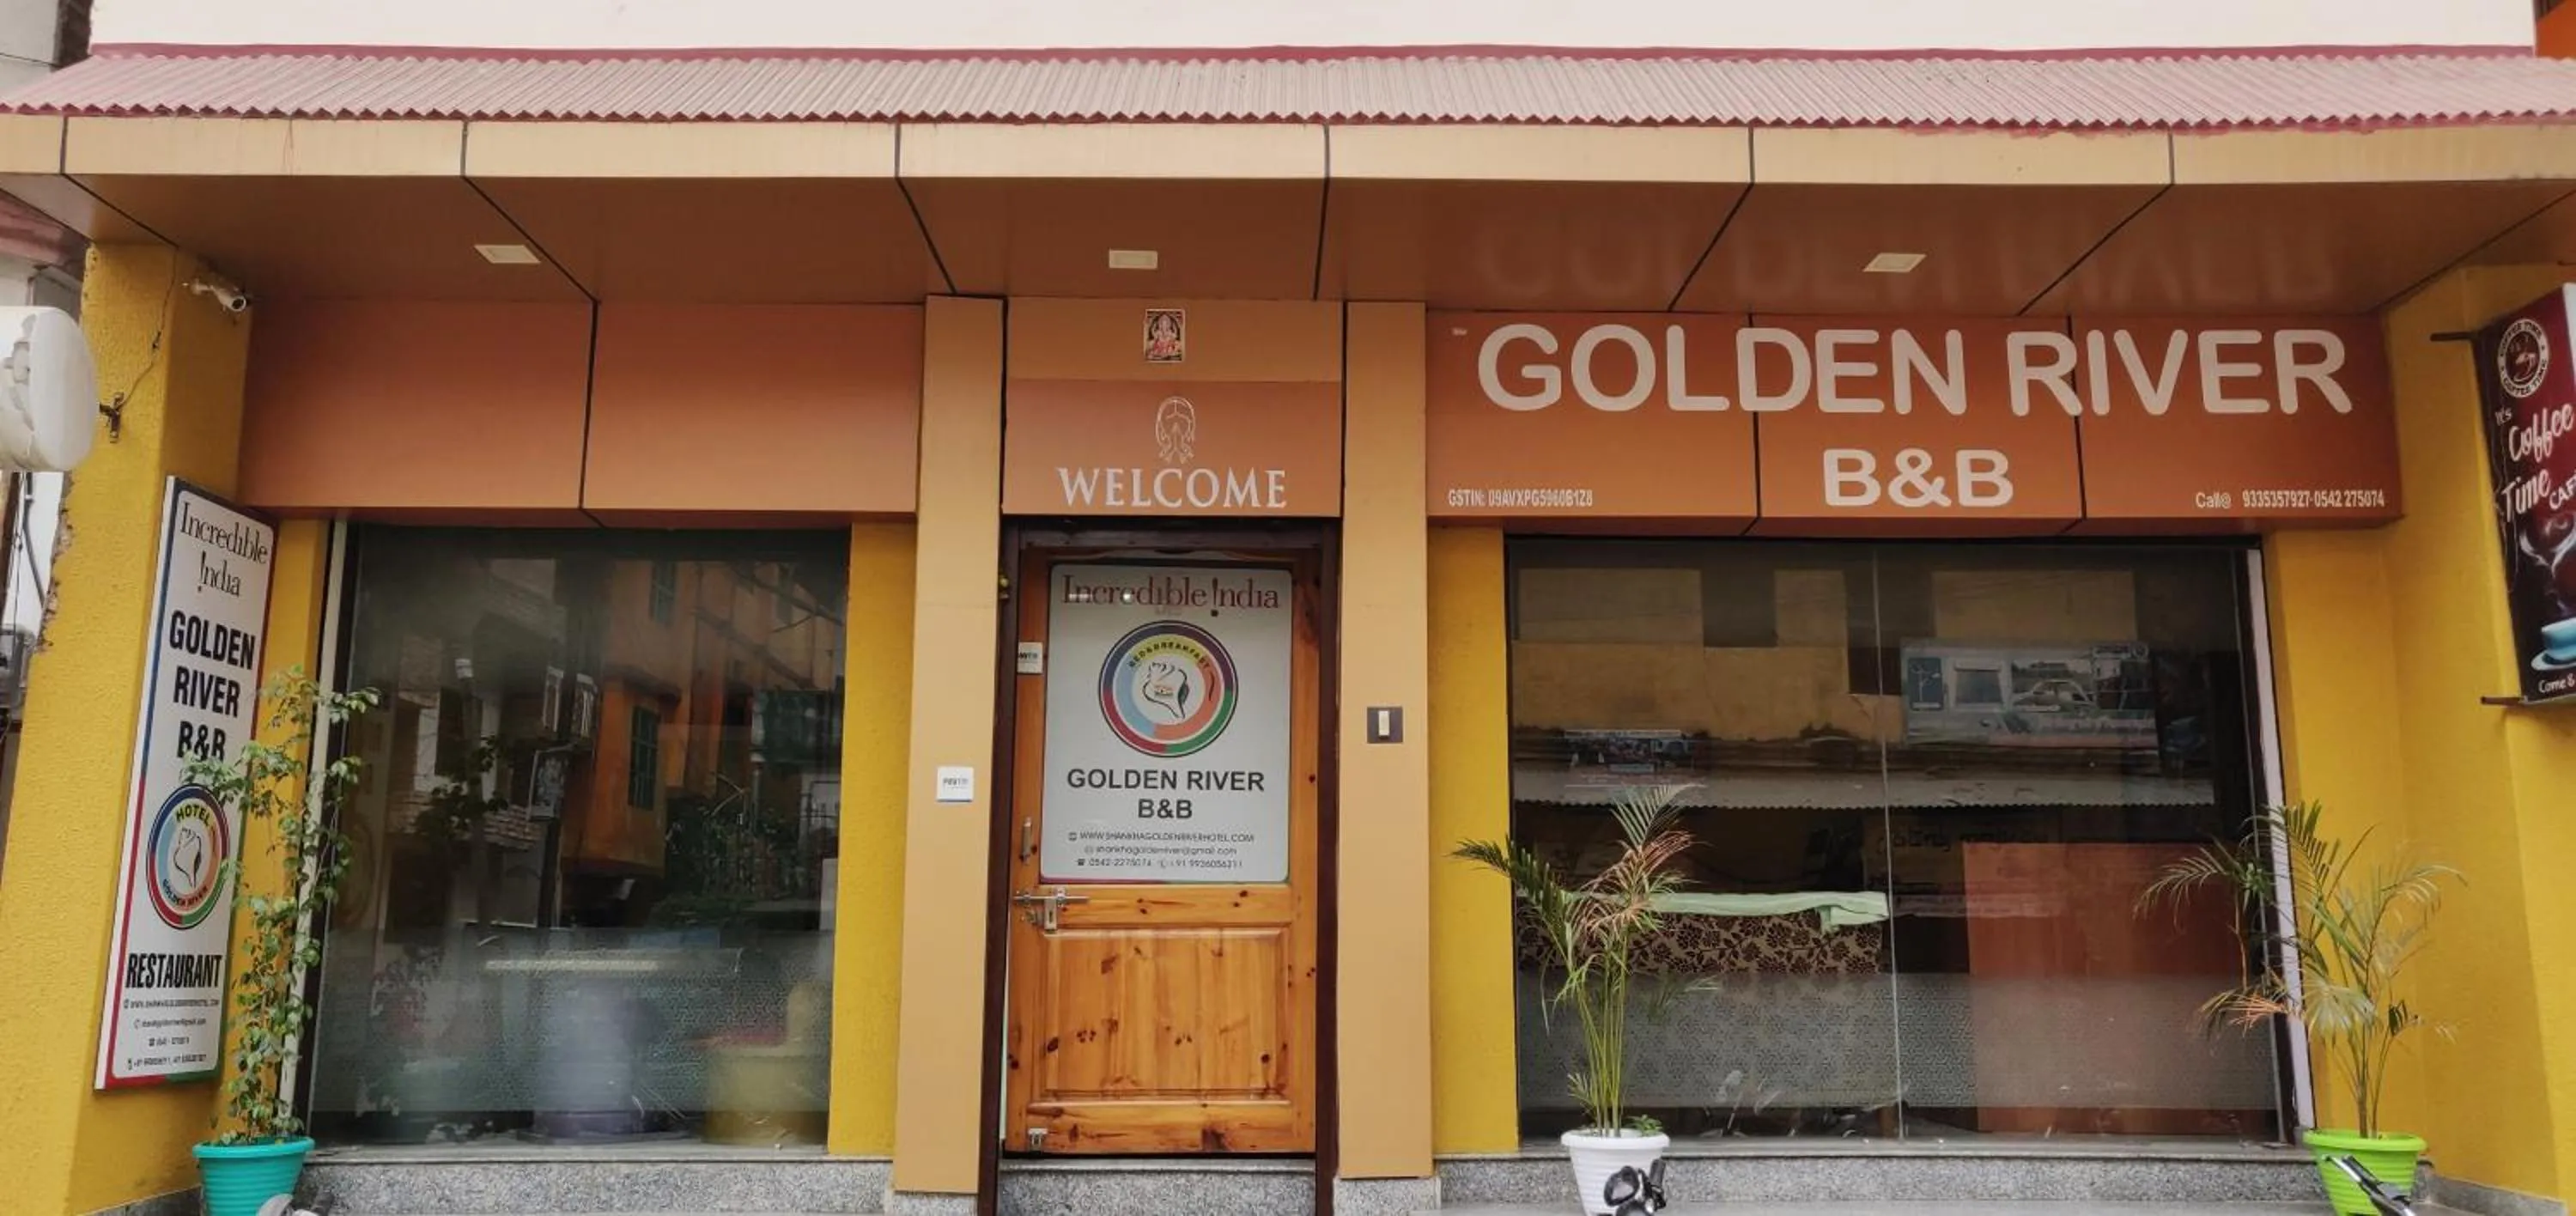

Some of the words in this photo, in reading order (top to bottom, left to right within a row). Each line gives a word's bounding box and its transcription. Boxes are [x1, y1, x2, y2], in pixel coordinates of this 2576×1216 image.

[1477, 324, 1968, 415] GOLDEN
[2007, 328, 2354, 416] RIVER
[2508, 403, 2574, 463] Coffee
[1057, 467, 1287, 508] WELCOME
[1449, 489, 1485, 507] GSTIN:
[1823, 448, 2014, 508] B&B
[2345, 489, 2385, 508] 275074
[2501, 469, 2550, 523] Time
[179, 501, 268, 565] Incredible
[1061, 575, 1207, 607] Incredible
[169, 610, 256, 671] GOLDEN
[173, 666, 241, 718] RIVER
[1067, 769, 1177, 790] GOLDEN
[1187, 770, 1265, 791] RIVER
[176, 804, 211, 827] HOTEL
[1138, 798, 1193, 818] B&B
[125, 952, 223, 989] RESTAURANT
